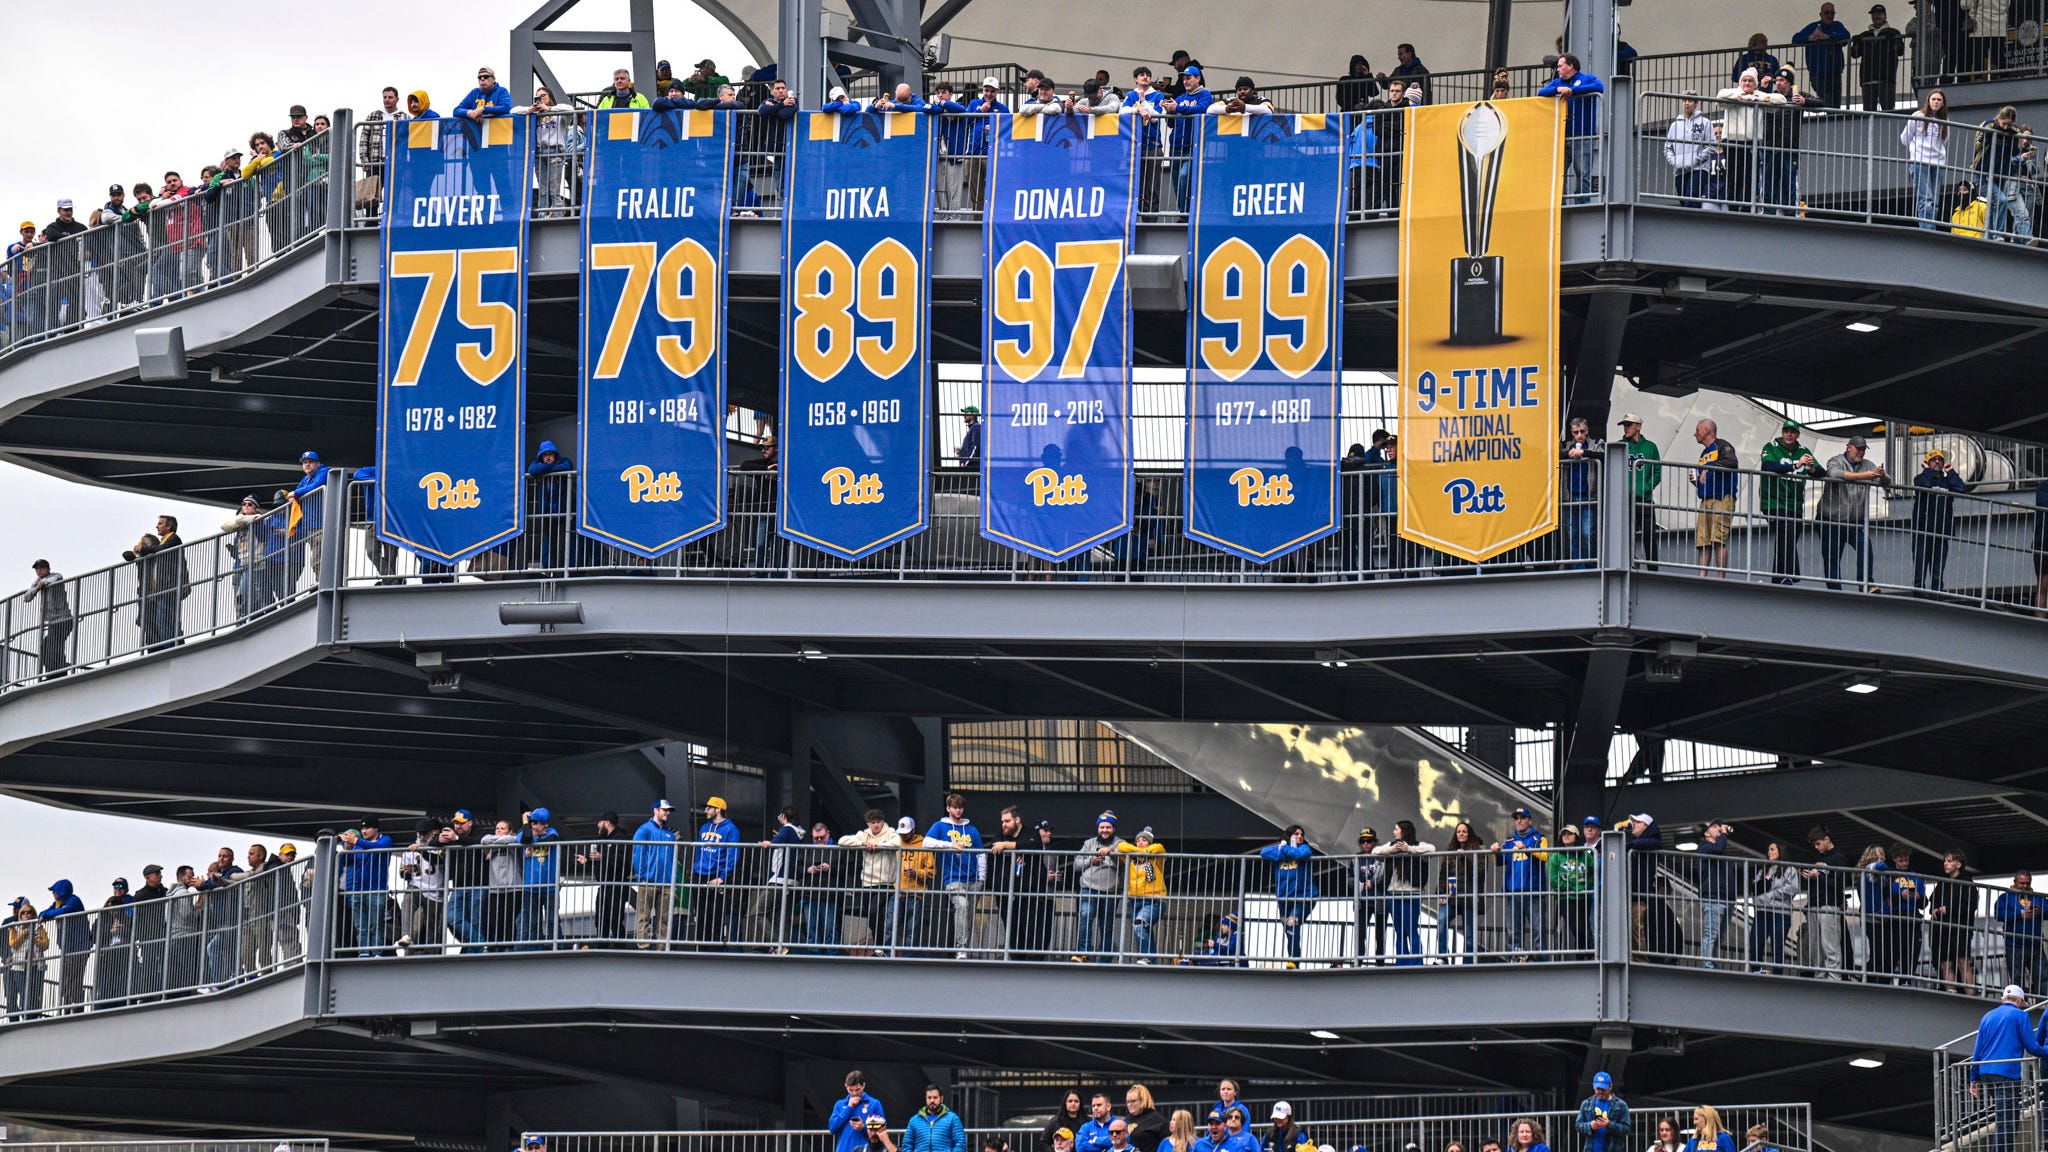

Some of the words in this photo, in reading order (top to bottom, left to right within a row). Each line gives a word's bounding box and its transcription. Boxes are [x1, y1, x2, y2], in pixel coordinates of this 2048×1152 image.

[413, 194, 500, 228] COVERT
[617, 186, 695, 220] FRALIC
[825, 186, 890, 220] DITKA
[1013, 186, 1105, 221] DONALD
[1232, 181, 1305, 217] GREEN
[389, 246, 518, 387] 75
[590, 236, 717, 380] 79
[794, 236, 919, 384] 89
[993, 239, 1124, 384] 97
[1200, 233, 1331, 382] 99
[1417, 364, 1540, 414] 9-TIME
[406, 407, 444, 431] 1978
[459, 404, 497, 429] 1982
[609, 400, 644, 424] 1981
[660, 398, 698, 423] 1984
[808, 402, 846, 426] 1958
[862, 400, 901, 424] 1960
[1011, 402, 1049, 427] 2010
[1066, 399, 1105, 425] 2013
[1215, 401, 1255, 427] 1977
[1271, 398, 1312, 424] 1980
[1438, 413, 1515, 438] NATIONAL
[1432, 437, 1522, 463] CHAMPIONS
[419, 471, 481, 510] Pitt
[620, 464, 683, 503] Pitt
[821, 466, 885, 506] Pitt
[1024, 467, 1089, 507] Pitt
[1228, 467, 1295, 507] Pitt
[1443, 477, 1507, 516] Pitt
